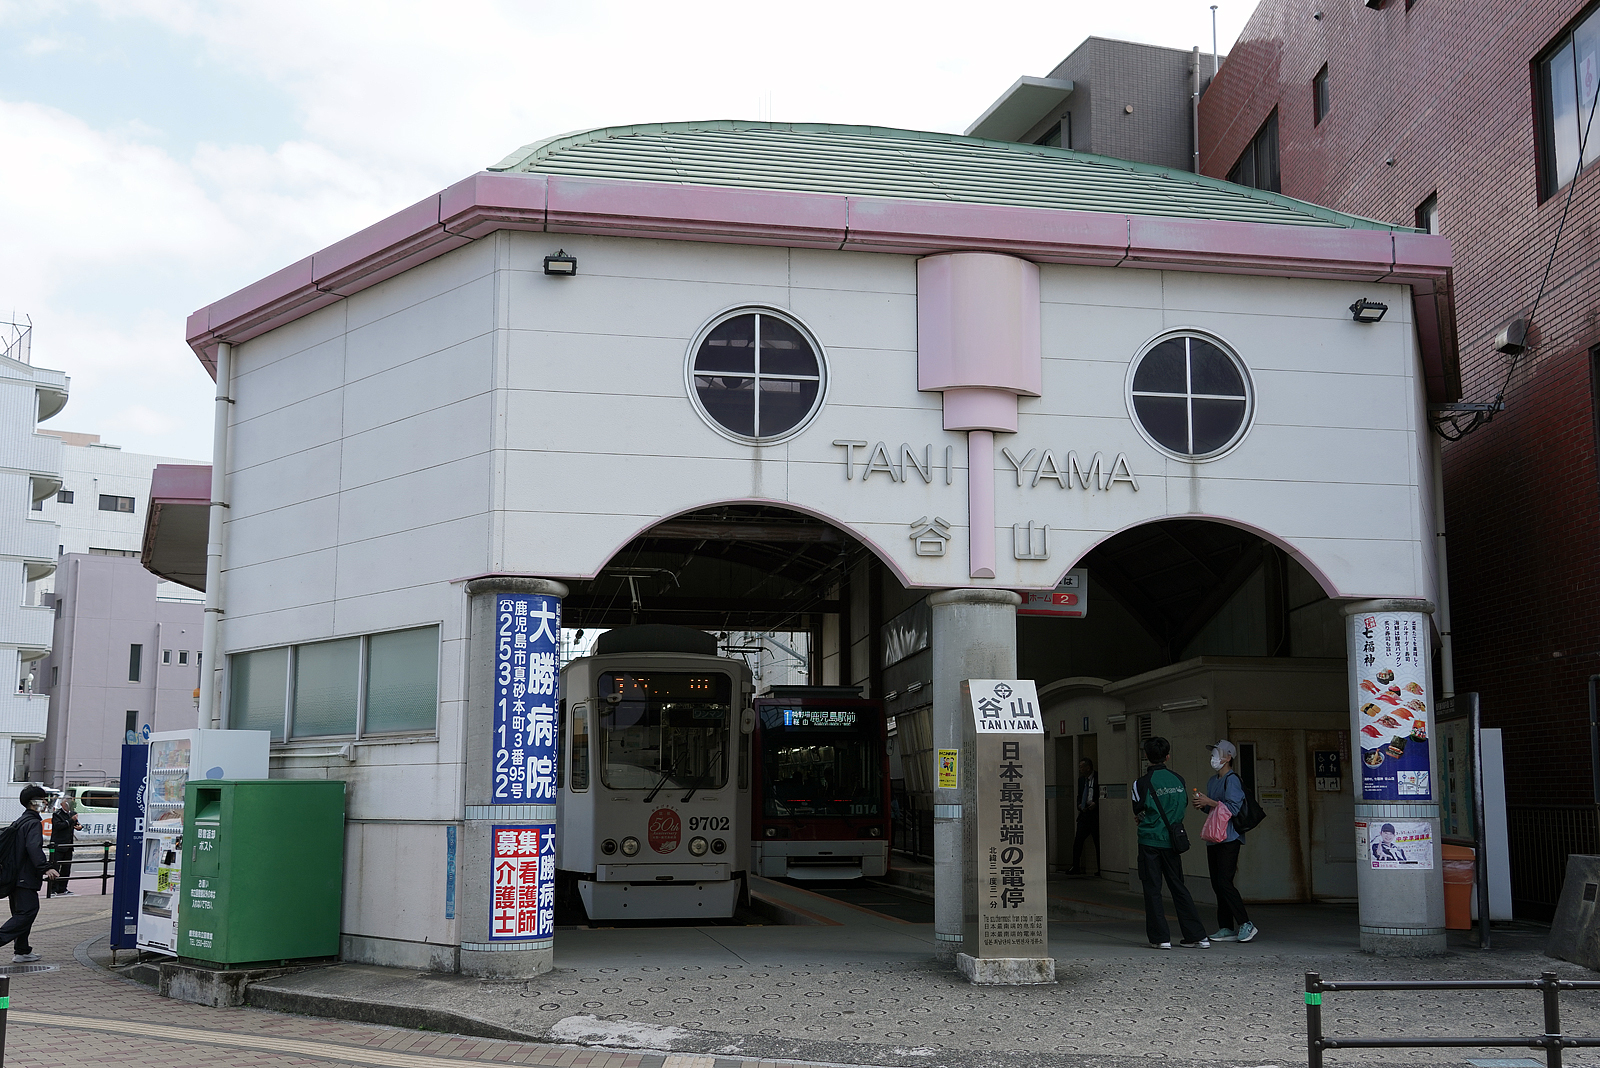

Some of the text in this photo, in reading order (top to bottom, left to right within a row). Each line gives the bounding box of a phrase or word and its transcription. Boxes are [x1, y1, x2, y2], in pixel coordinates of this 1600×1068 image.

[832, 439, 1140, 492] TANI YAMA
[1029, 594, 1070, 604] ホーム 2
[1362, 627, 1376, 668] 七福神
[1403, 620, 1411, 662] フルオーダー寿司
[509, 600, 528, 799] 鹿児島市真砂本町3番95号
[526, 600, 556, 799] 大勝病院
[693, 710, 725, 718] ワンマン
[978, 697, 1035, 719] 谷山
[784, 711, 790, 725] 1
[810, 711, 856, 723] 鹿児島駅前
[980, 720, 1039, 730] TANIYAMA
[689, 816, 730, 831] 9702
[850, 804, 878, 815] 1014
[999, 741, 1025, 909] 日本最南端の電停
[199, 841, 214, 851] ポスト
[496, 830, 538, 856] 募集
[539, 827, 556, 936] 大勝病院
[989, 846, 998, 909] 北緯三一度三一分
[494, 860, 517, 934] 介護士
[518, 860, 538, 934] 看護師
